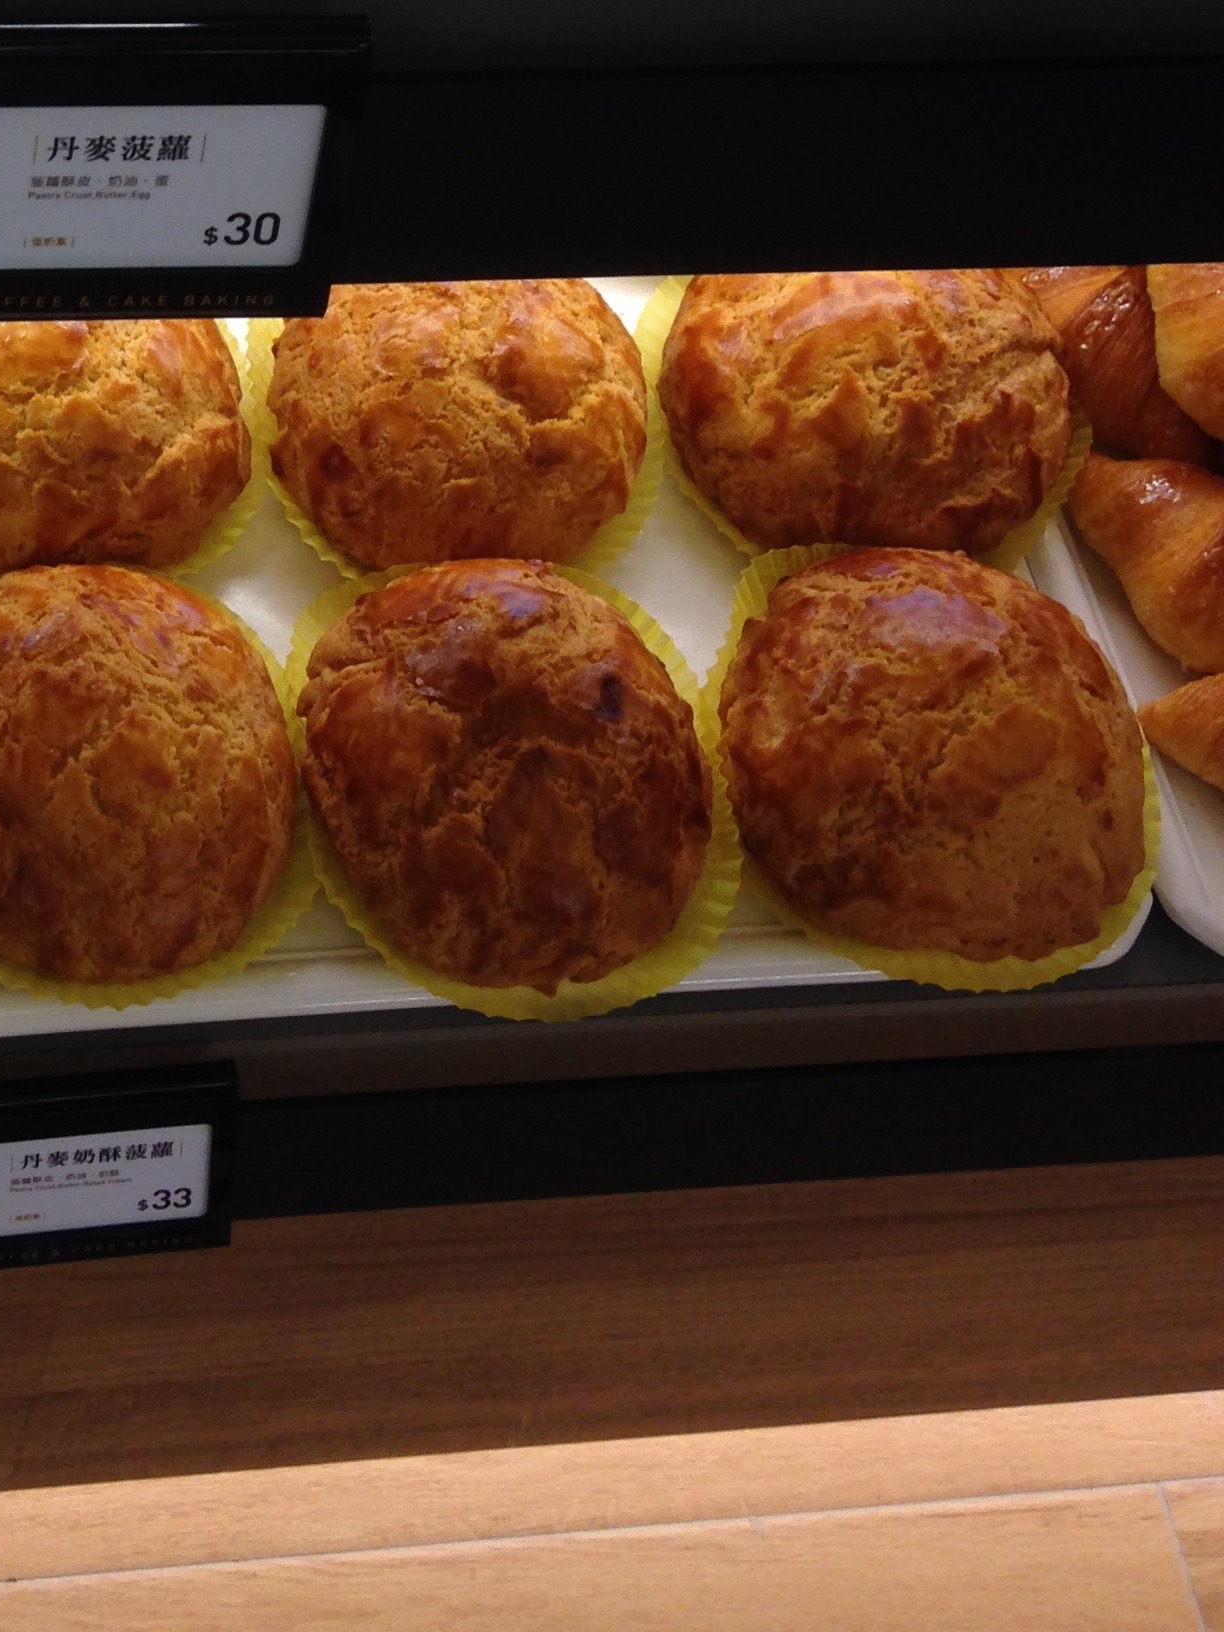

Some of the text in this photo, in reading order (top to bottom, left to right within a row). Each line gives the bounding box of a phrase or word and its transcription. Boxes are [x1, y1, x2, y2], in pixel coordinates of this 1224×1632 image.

[46, 134, 193, 163] 丹麥菠蘿
[202, 211, 282, 247] $30
[78, 295, 90, 308] &
[107, 294, 169, 307] CAKE
[183, 294, 276, 307] BAKING
[21, 1141, 174, 1170] 丹麥奶酥菠蘿
[137, 1187, 192, 1212] $33
